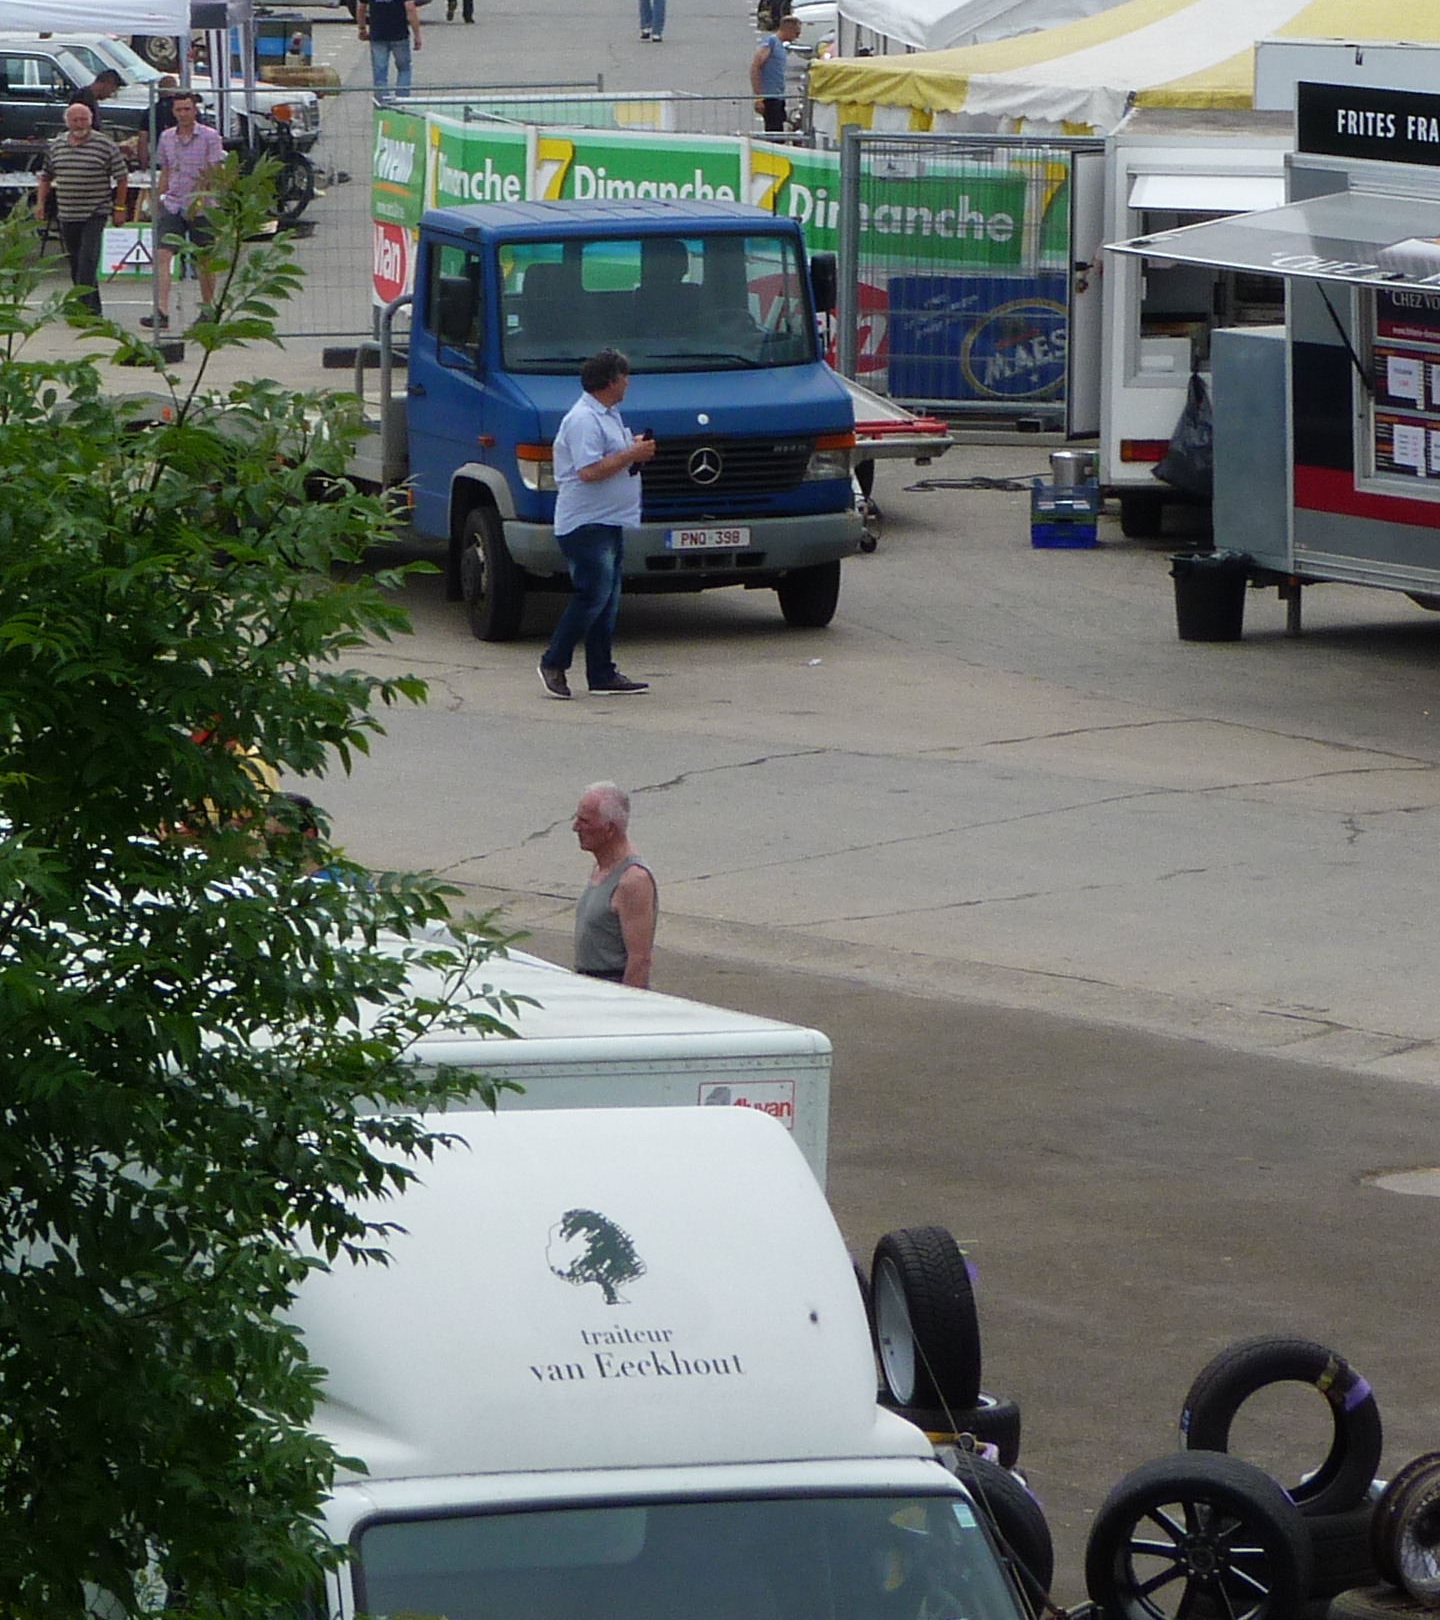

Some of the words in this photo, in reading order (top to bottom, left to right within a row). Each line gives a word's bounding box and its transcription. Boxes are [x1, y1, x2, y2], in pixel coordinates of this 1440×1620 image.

[1337, 109, 1396, 139] FRITES
[574, 164, 735, 202] Dimanche
[788, 183, 1015, 243] Dimanche
[581, 1325, 673, 1345] traiteur
[530, 1360, 586, 1382] van
[594, 1350, 747, 1378] Eeckhout
